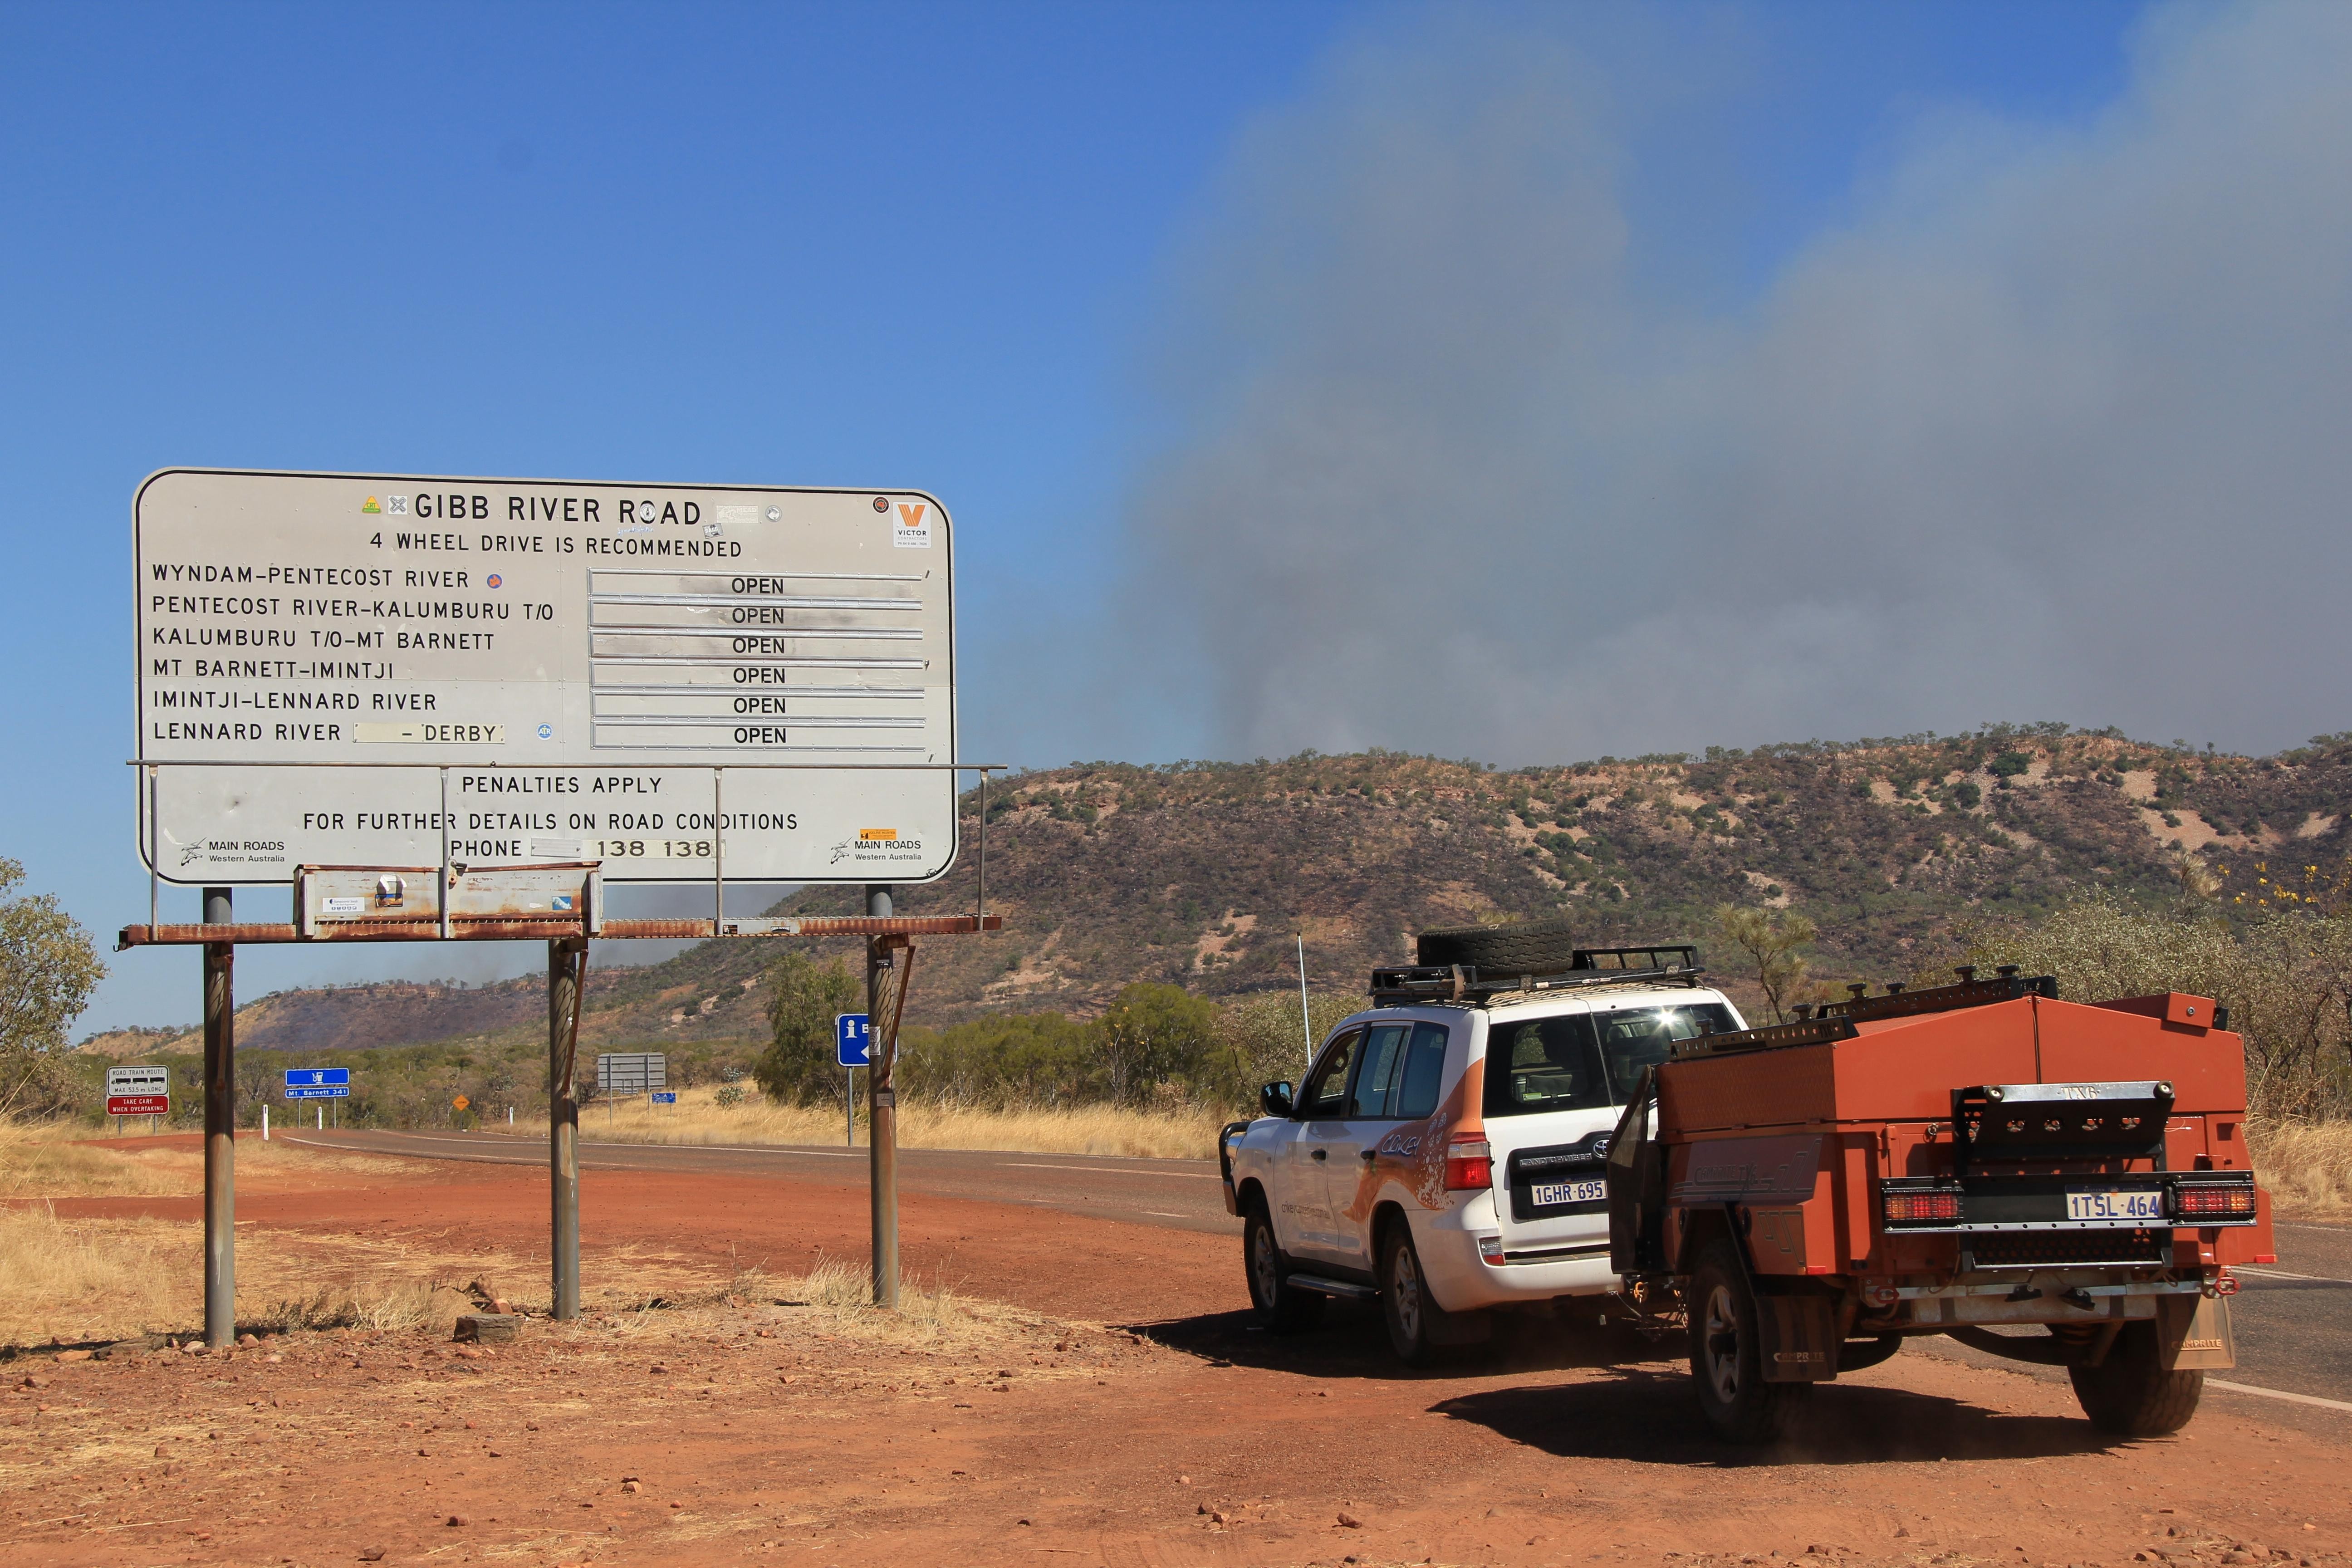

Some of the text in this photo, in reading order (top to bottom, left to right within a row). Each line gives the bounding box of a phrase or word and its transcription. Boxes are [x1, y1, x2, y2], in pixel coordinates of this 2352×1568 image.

[415, 493, 489, 519] GIBB
[509, 496, 600, 522] RIVER
[620, 500, 700, 525] ROAD
[370, 532, 741, 557] 4 WHEEL DRIVE IS RECOMMENDED
[152, 564, 468, 588] WYNDAM-PENTECOST RIVER
[731, 578, 784, 594] OPEN
[153, 596, 553, 620] PENTECOST RIVER-KALUMBURU T/O
[732, 608, 784, 624] OPEN
[153, 627, 494, 650] KALUMBURU T/O-MT BARNETT
[733, 637, 784, 654] OPEN
[154, 659, 392, 679] MT BARNETT-IMINTJI
[733, 667, 785, 684] OPEN
[154, 691, 436, 710] IMINTJI-LENNARD RIVER
[734, 697, 785, 714] OPEN
[155, 722, 262, 740] LENNARD
[276, 724, 340, 740] RIVER
[426, 725, 495, 741] DERBY
[734, 727, 786, 744] OPEN
[463, 776, 662, 793] PENALTIES APPLY
[304, 813, 797, 830] FOR FURTHER DETAILS ON ROAD CONDITIONS
[209, 841, 284, 851] MAIN ROADS
[451, 840, 710, 857] PHONE 138 138
[855, 841, 921, 849] MAIN ROADS
[2060, 1085, 2097, 1100] TX6
[1520, 1153, 1592, 1167] LAND CRUISER
